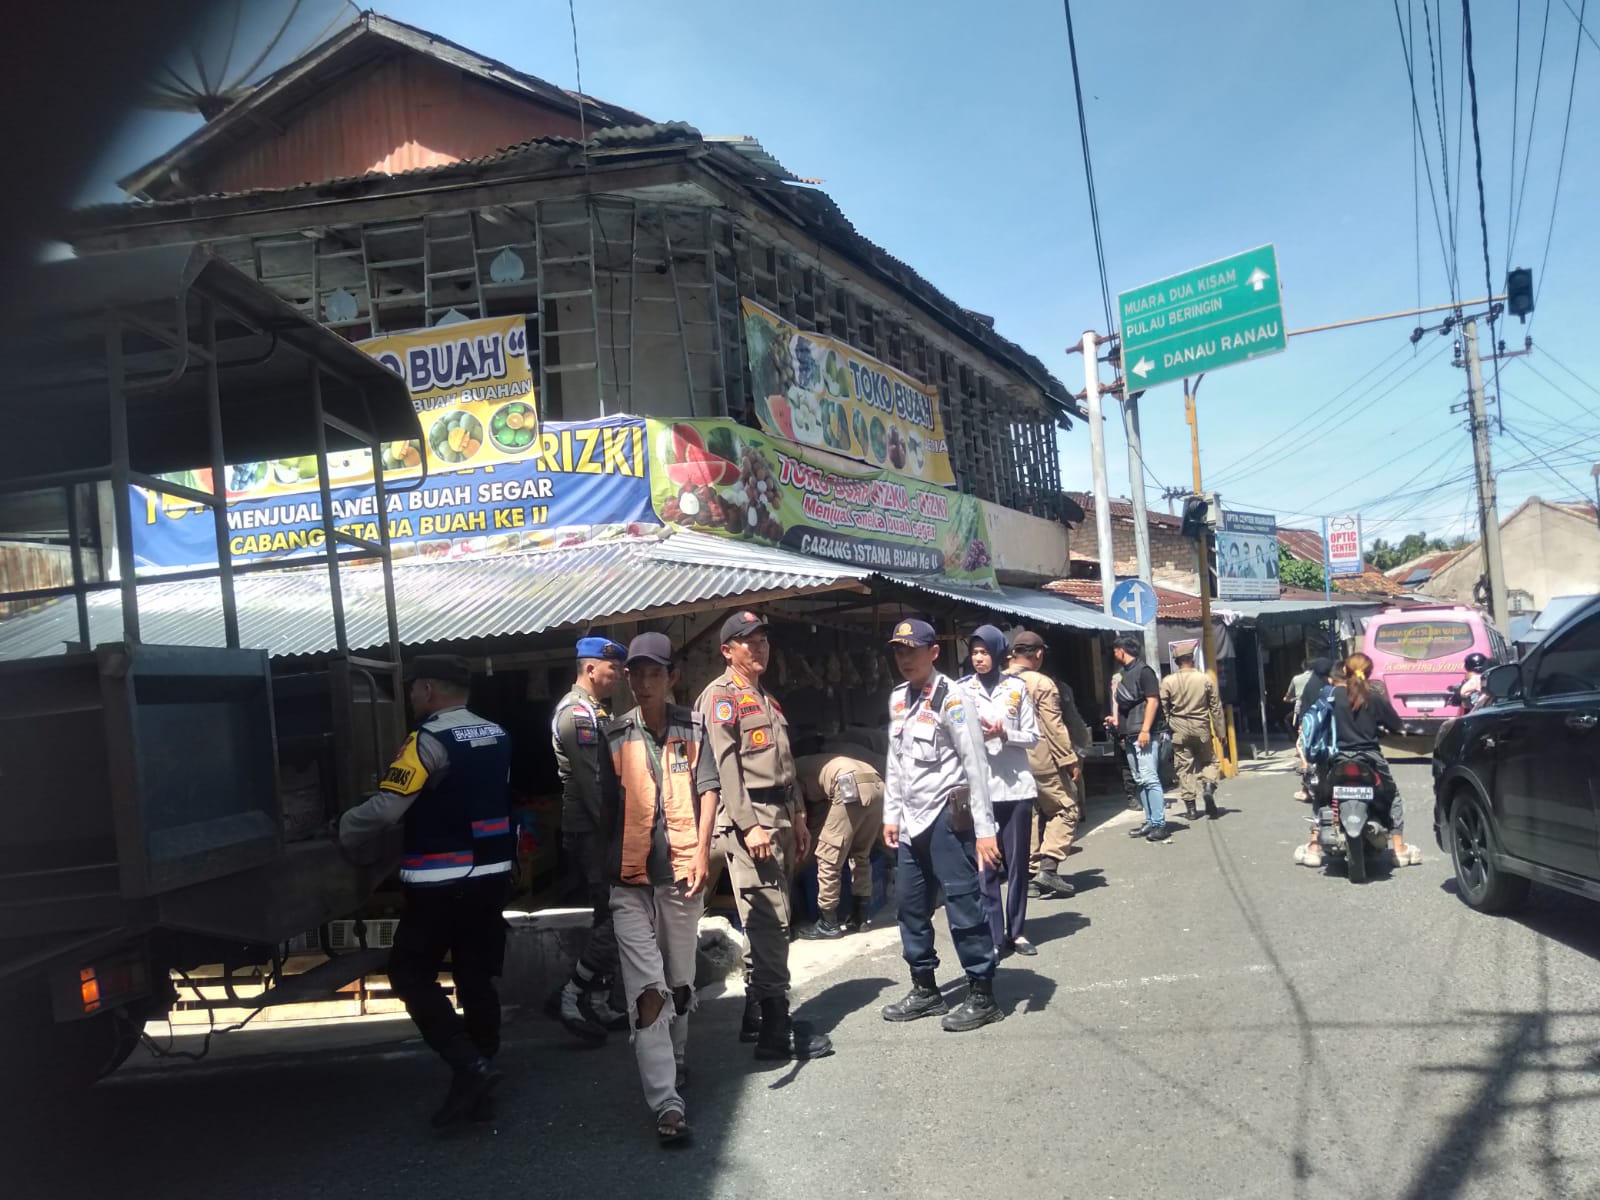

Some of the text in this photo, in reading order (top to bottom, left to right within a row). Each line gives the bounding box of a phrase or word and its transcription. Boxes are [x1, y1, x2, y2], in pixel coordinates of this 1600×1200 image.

[1124, 269, 1236, 316] MUARA DUA KISAM
[1126, 297, 1222, 338] PULAU BERINGIN
[410, 335, 502, 389] BUAH
[1164, 322, 1278, 368] DANAU RANAU
[412, 379, 532, 413] BUAH BUAHAN
[848, 360, 934, 431] TOKO BUAH
[536, 426, 645, 478] RIZKI
[226, 504, 322, 531] MENJUAL
[409, 486, 472, 510] BUAH
[478, 478, 553, 502] SEGAR
[803, 495, 854, 528] Menjual
[853, 510, 886, 532] aneka
[886, 512, 912, 536] buah
[917, 490, 949, 521] RIZKI
[229, 528, 326, 556] CABANG
[419, 511, 486, 535] BUAH
[494, 508, 525, 530] KE
[801, 534, 851, 562] CABANG
[853, 544, 891, 565] ISTANA
[894, 549, 918, 567] BUAH
[1330, 531, 1357, 543] OPTIC
[1330, 543, 1357, 552] CENTER
